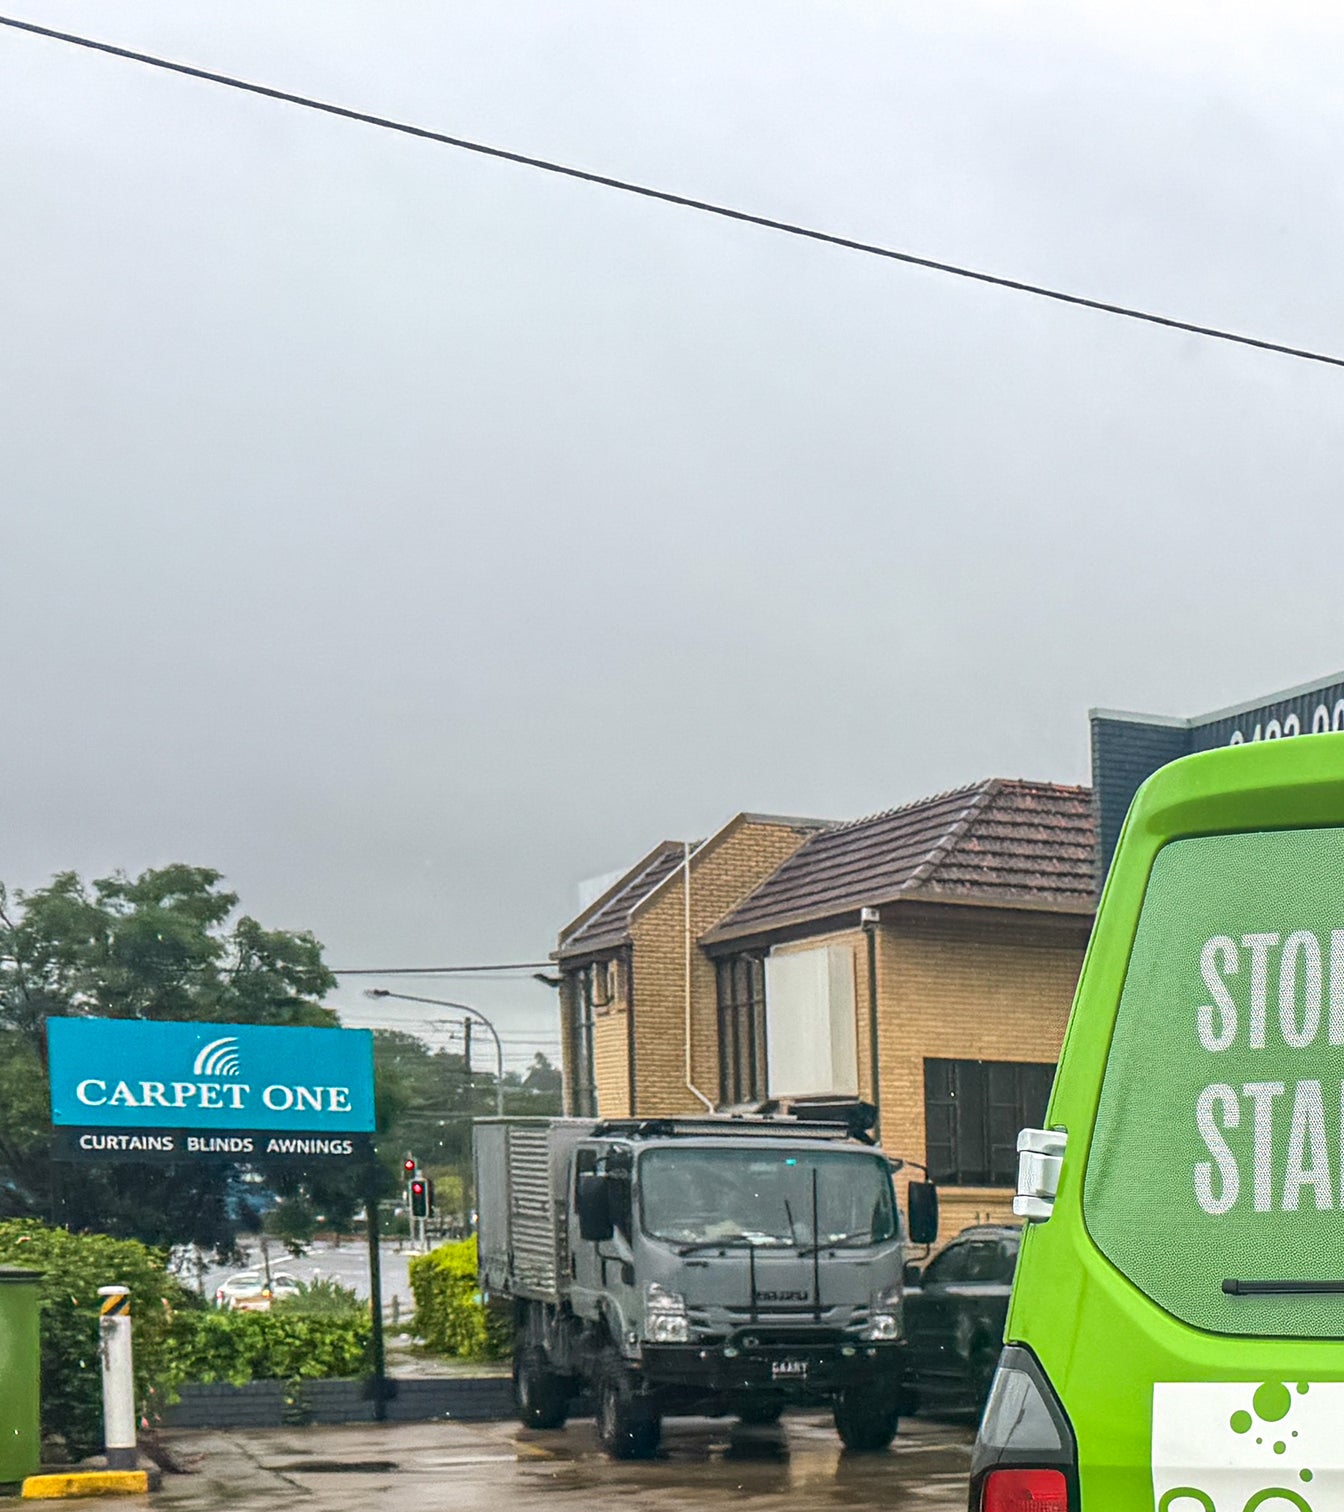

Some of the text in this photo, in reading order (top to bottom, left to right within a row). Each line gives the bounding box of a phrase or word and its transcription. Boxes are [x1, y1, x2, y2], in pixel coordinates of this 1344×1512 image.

[76, 1079, 351, 1112] CARPET ONE
[79, 1135, 353, 1155] CURTAINS BLINDS AWNINGS
